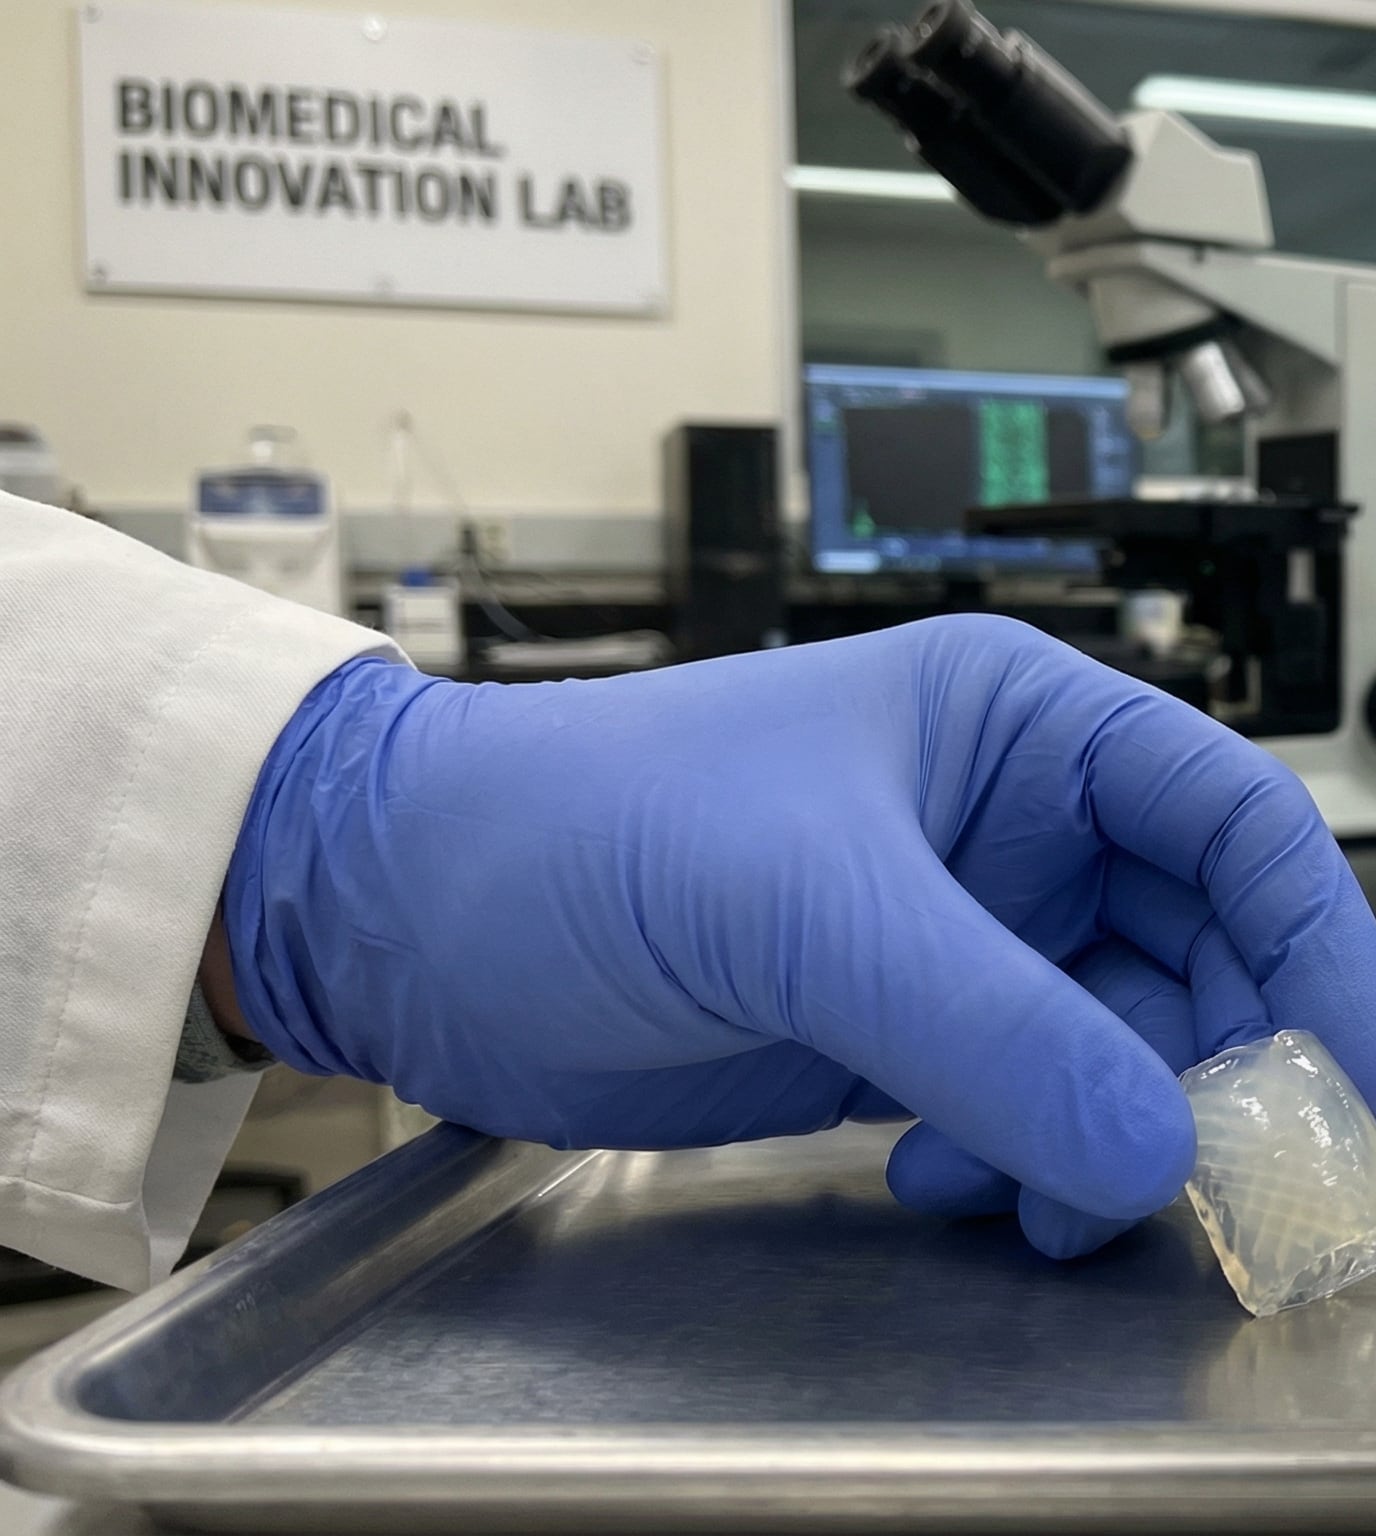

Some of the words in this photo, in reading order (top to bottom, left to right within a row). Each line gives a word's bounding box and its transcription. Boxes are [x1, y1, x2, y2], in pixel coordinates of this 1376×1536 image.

[115, 78, 503, 158] BIOMEDICAL
[117, 151, 497, 223] INNOVATION
[518, 175, 631, 232] LAB
